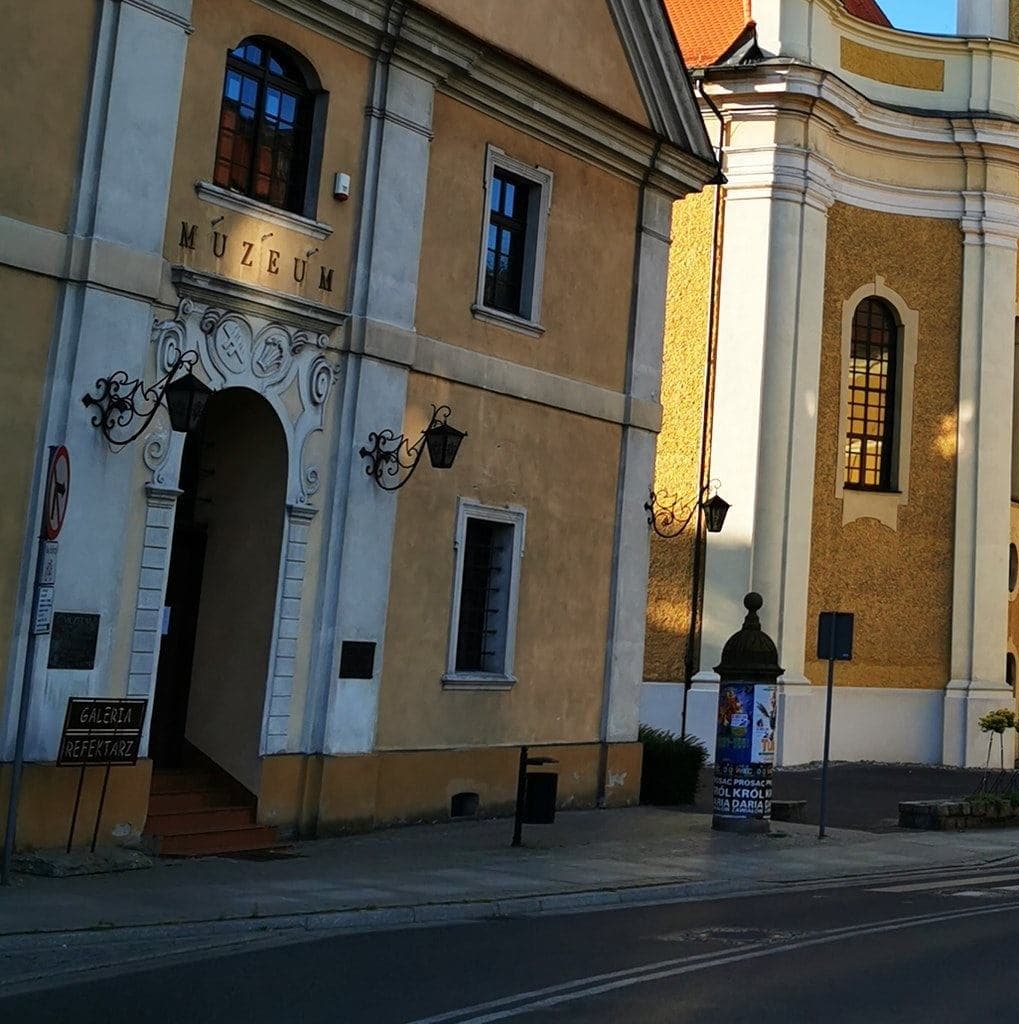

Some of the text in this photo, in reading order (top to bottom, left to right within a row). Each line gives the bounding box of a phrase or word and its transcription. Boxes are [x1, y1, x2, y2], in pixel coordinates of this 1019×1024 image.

[178, 221, 335, 292] MUZEUM
[79, 706, 132, 724] GALERIA
[64, 739, 134, 758] REFEKTARZ
[732, 786, 764, 799] KRÓL
[731, 799, 763, 809] DARIA
